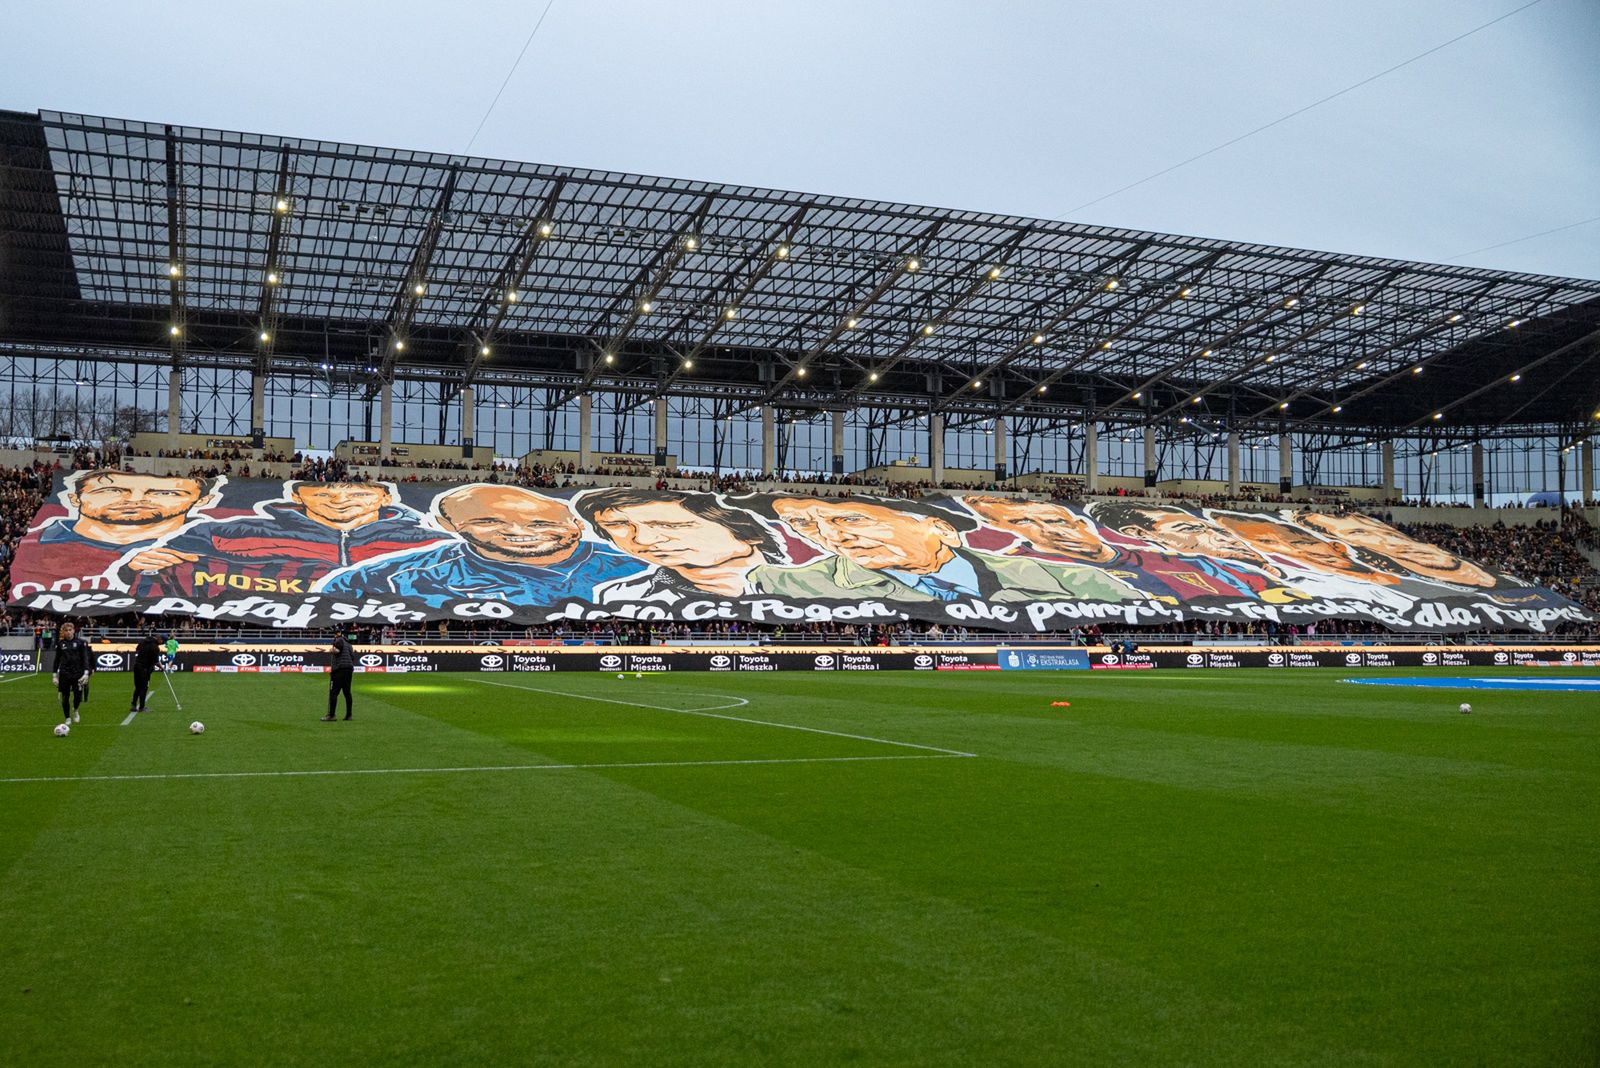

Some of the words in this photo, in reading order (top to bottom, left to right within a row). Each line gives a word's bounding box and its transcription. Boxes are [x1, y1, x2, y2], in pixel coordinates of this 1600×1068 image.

[194, 571, 318, 594] MOSK
[28, 594, 137, 612] Nie
[453, 602, 514, 619] co
[682, 600, 739, 620] Ci
[945, 599, 1018, 622] ale
[1413, 602, 1481, 627] dla
[1470, 603, 1593, 631] Pogoni
[0, 654, 31, 663] oyota
[268, 654, 303, 663] Toyota
[394, 655, 428, 664] Toyota
[513, 655, 547, 664] Toyota
[631, 655, 663, 664] Toyota
[739, 655, 770, 664] Toyota
[842, 655, 871, 664] Toyota
[940, 655, 968, 664] Toyota
[1125, 654, 1150, 663] Toyota
[1210, 654, 1233, 662] Toyota
[1290, 653, 1313, 662] Toyota
[1367, 653, 1389, 661] Toyota
[1443, 653, 1464, 661] Toyota
[1513, 653, 1534, 661] Toyota
[0, 663, 36, 671] ieszka
